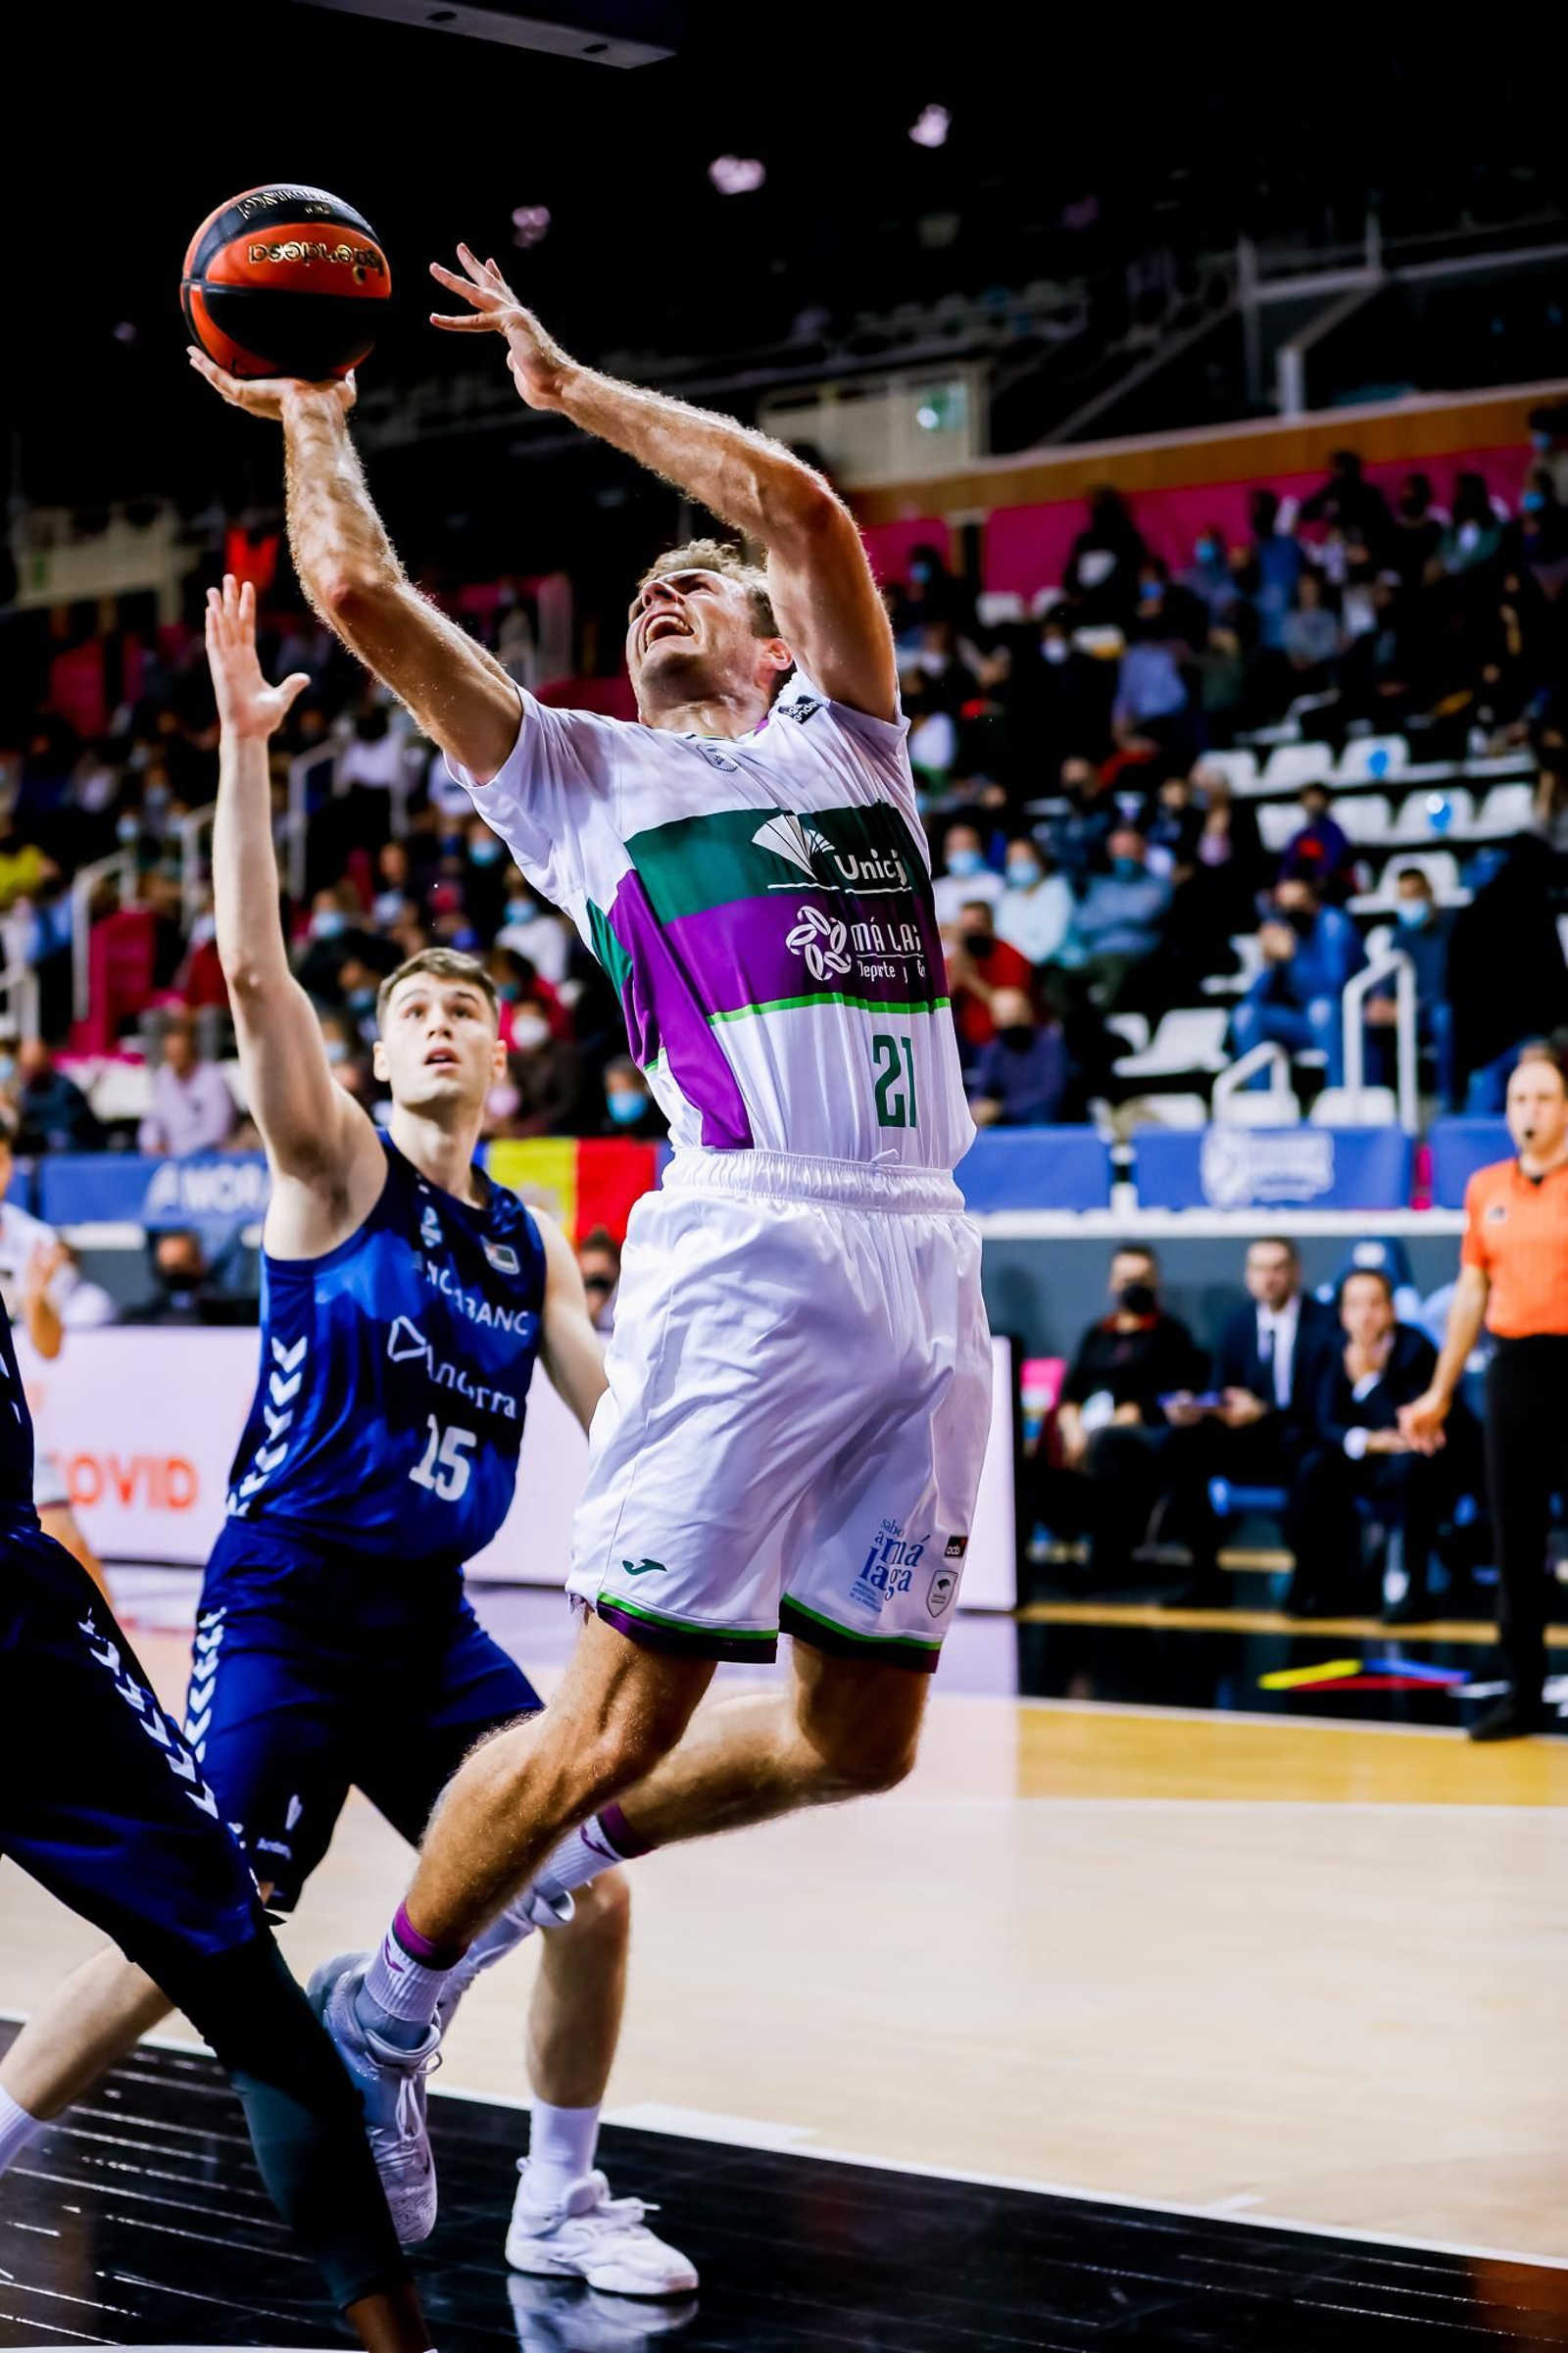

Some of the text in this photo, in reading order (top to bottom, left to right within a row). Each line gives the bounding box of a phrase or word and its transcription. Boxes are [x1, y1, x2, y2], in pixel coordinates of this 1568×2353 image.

[874, 1035, 916, 1128] 21
[57, 1449, 200, 1510] OVID
[409, 1413, 477, 1501] 15
[881, 1519, 905, 1538] sabo
